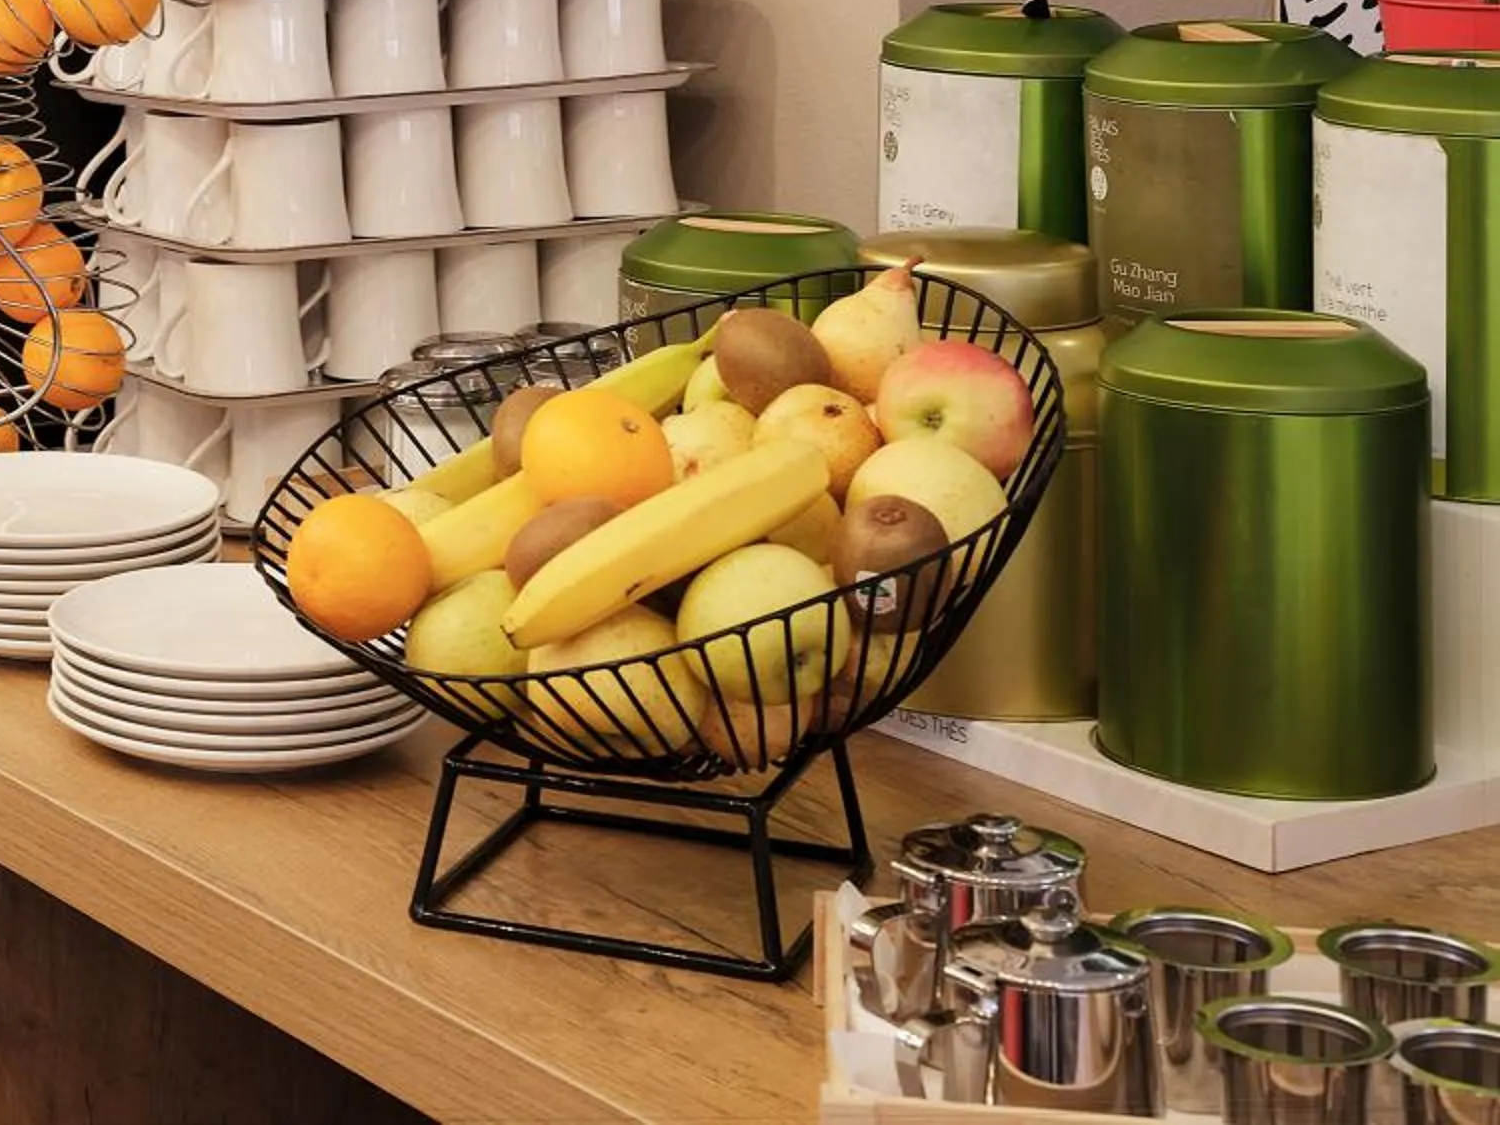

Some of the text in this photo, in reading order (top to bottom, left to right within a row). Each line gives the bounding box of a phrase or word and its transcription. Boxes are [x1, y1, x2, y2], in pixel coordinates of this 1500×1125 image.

[1110, 259, 1177, 288] Gu Zhang
[1113, 279, 1139, 298] Mao
